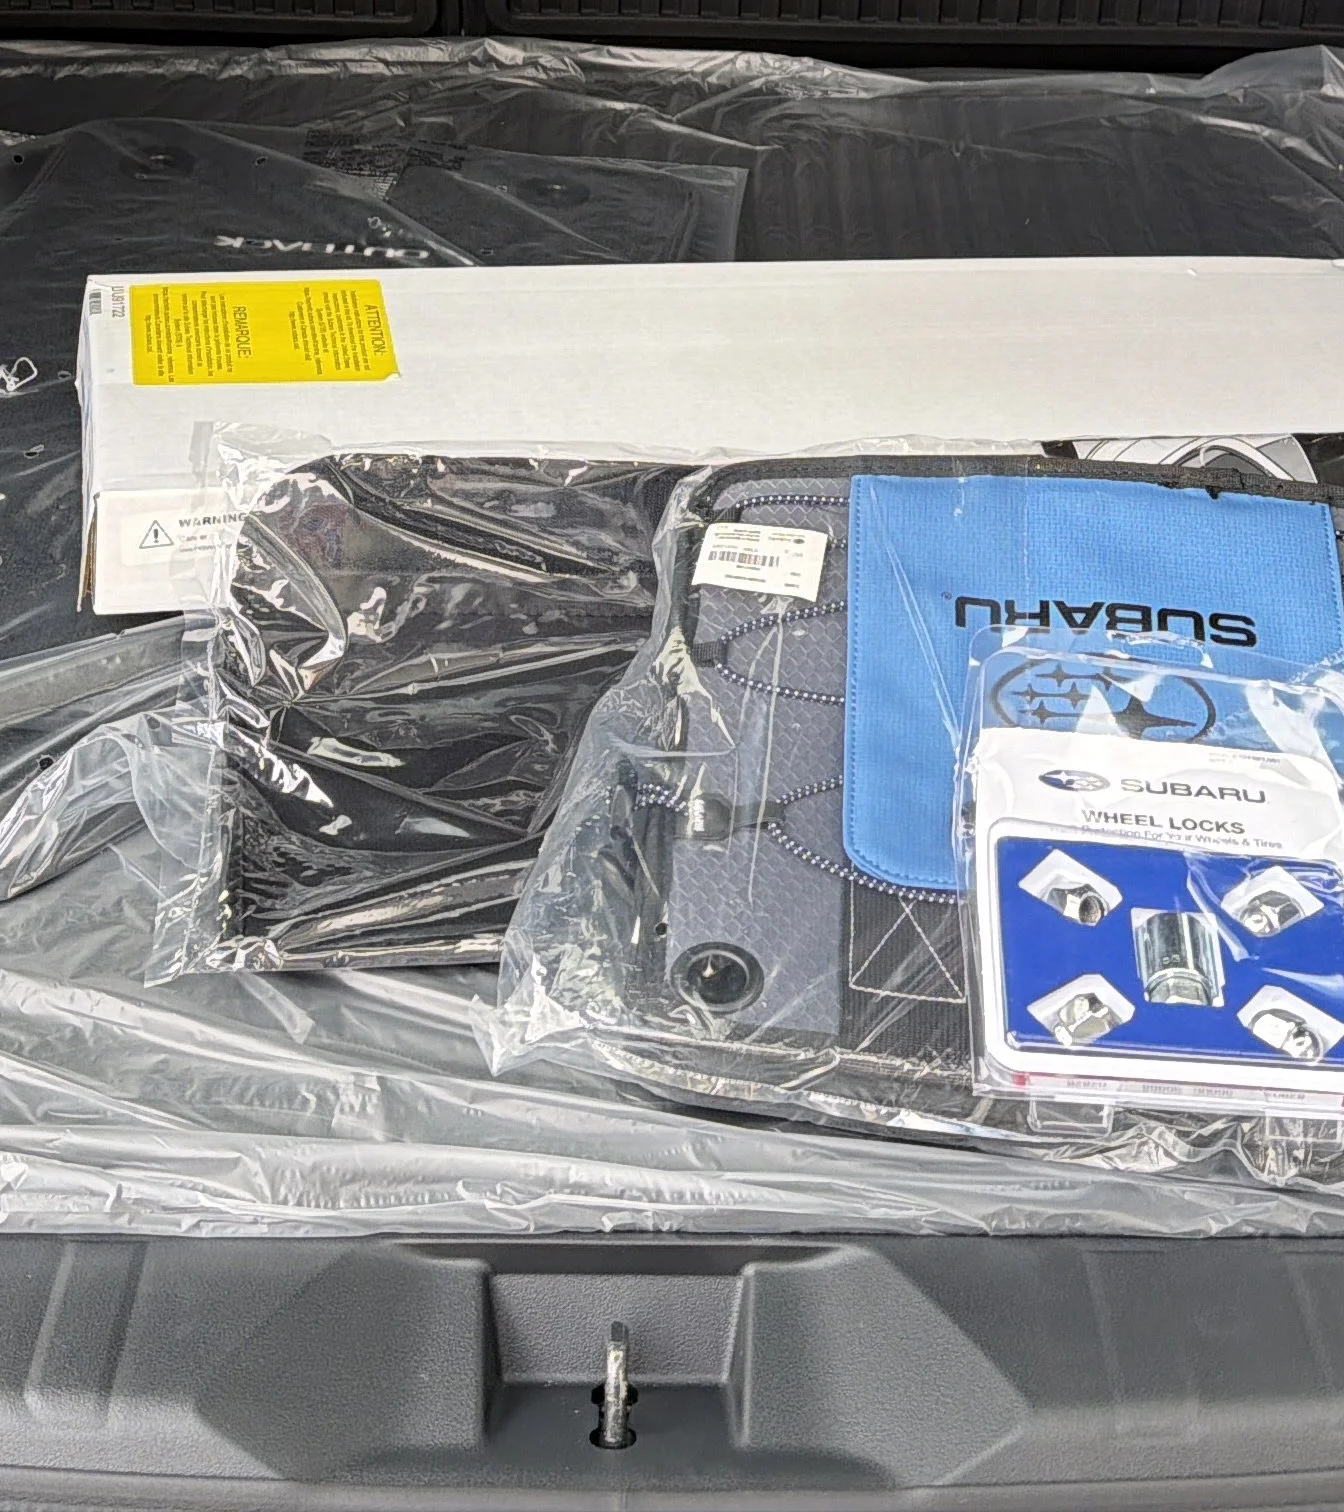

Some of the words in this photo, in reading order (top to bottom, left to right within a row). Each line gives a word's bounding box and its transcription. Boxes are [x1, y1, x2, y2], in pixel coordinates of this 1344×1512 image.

[233, 305, 252, 359] REMARQUE:
[363, 304, 387, 356] ATTENTION:
[955, 596, 1257, 648] SUBARU
[1120, 778, 1268, 804] SUBARU
[1082, 809, 1163, 829] WHEEL
[1168, 816, 1245, 835] LOCKS
[1145, 830, 1163, 840] For
